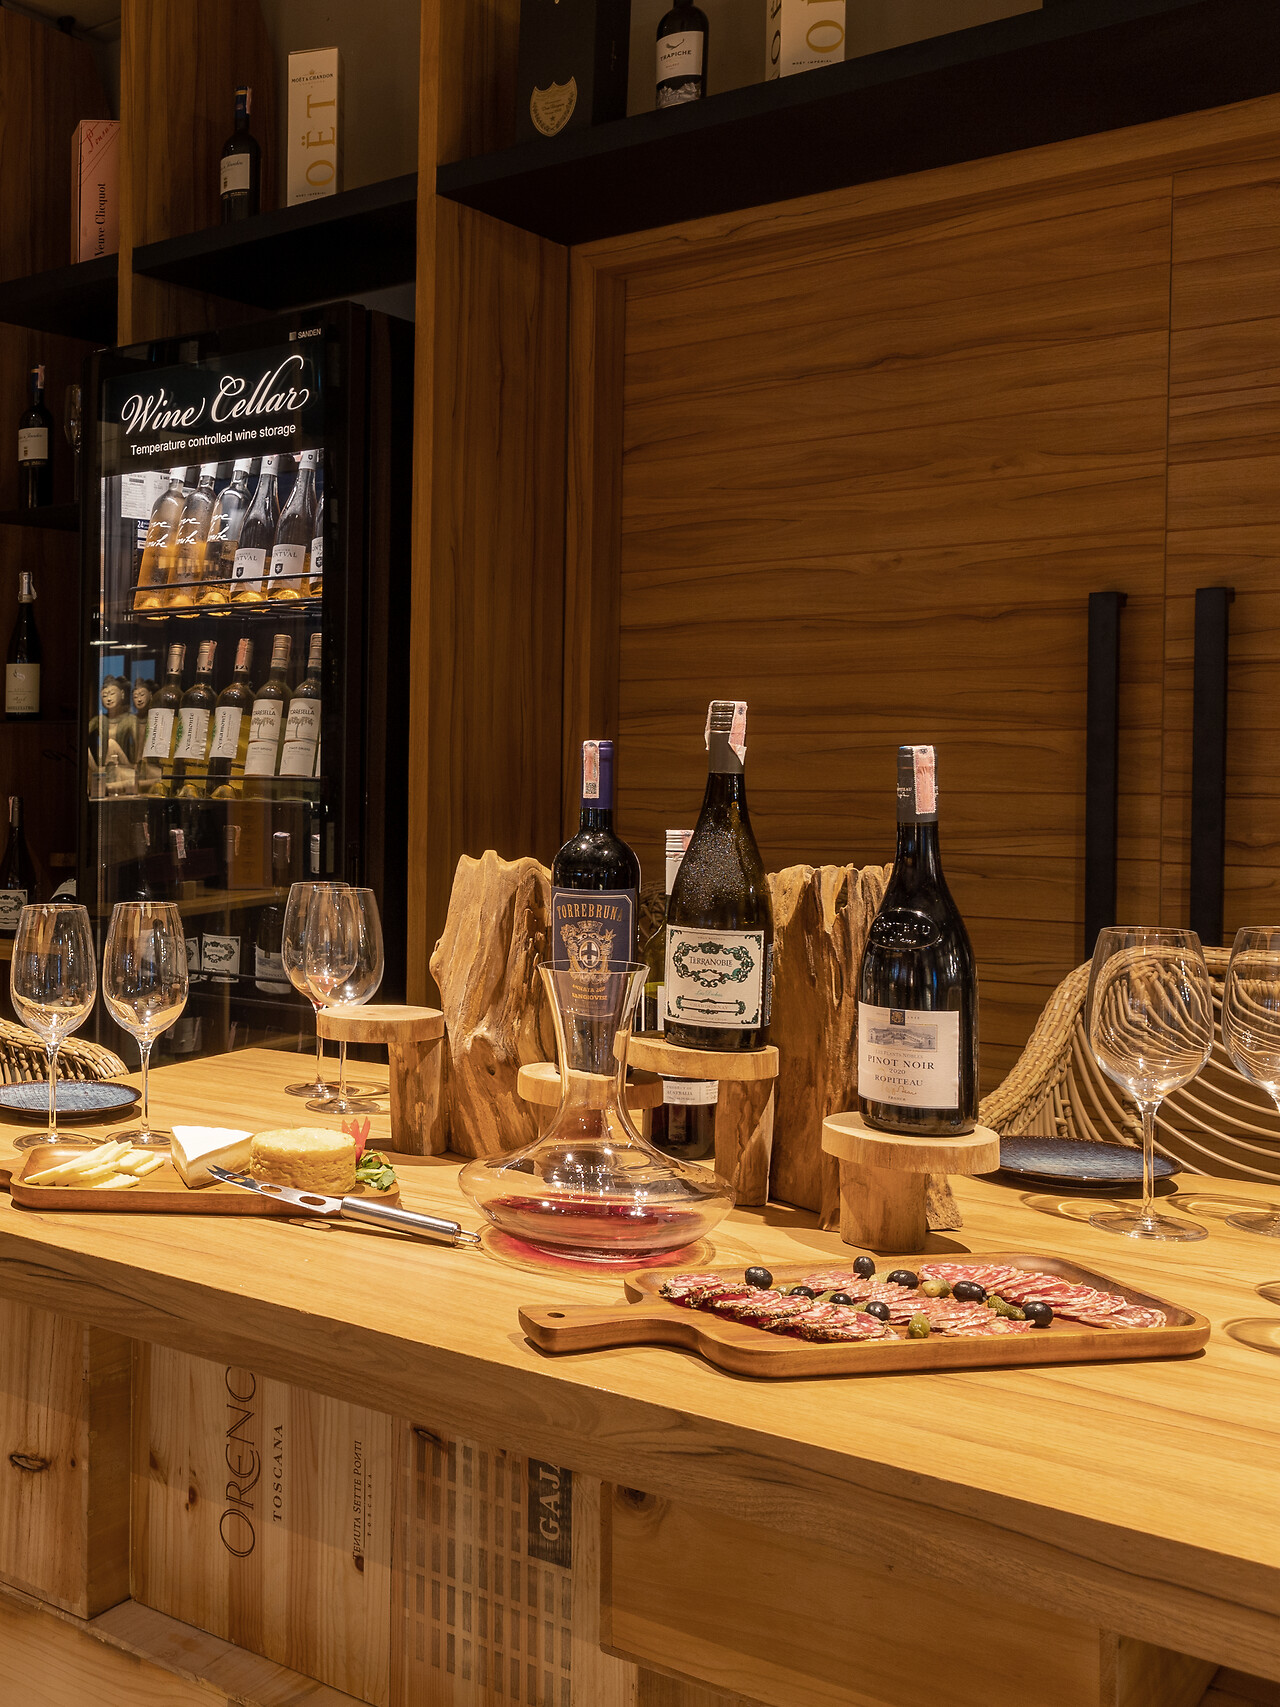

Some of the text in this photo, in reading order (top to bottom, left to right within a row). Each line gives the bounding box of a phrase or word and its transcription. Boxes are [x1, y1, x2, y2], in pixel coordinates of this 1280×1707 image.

[660, 50, 692, 62] TRAPICHE
[94, 184, 108, 256] Veuve Clicquot
[298, 328, 321, 339] SANDEN
[121, 354, 310, 434] Wine Cellar
[130, 424, 296, 456] Temperature controlled wine storage
[689, 956, 733, 968] TERRANOBLE
[868, 1054, 934, 1070] PINOT NOIR
[874, 1074, 923, 1086] ROPITEAU
[272, 1424, 284, 1523] TOSCANA
[354, 1440, 362, 1476] PONTI
[352, 1478, 362, 1514] SETTE
[540, 1463, 560, 1541] GAJ
